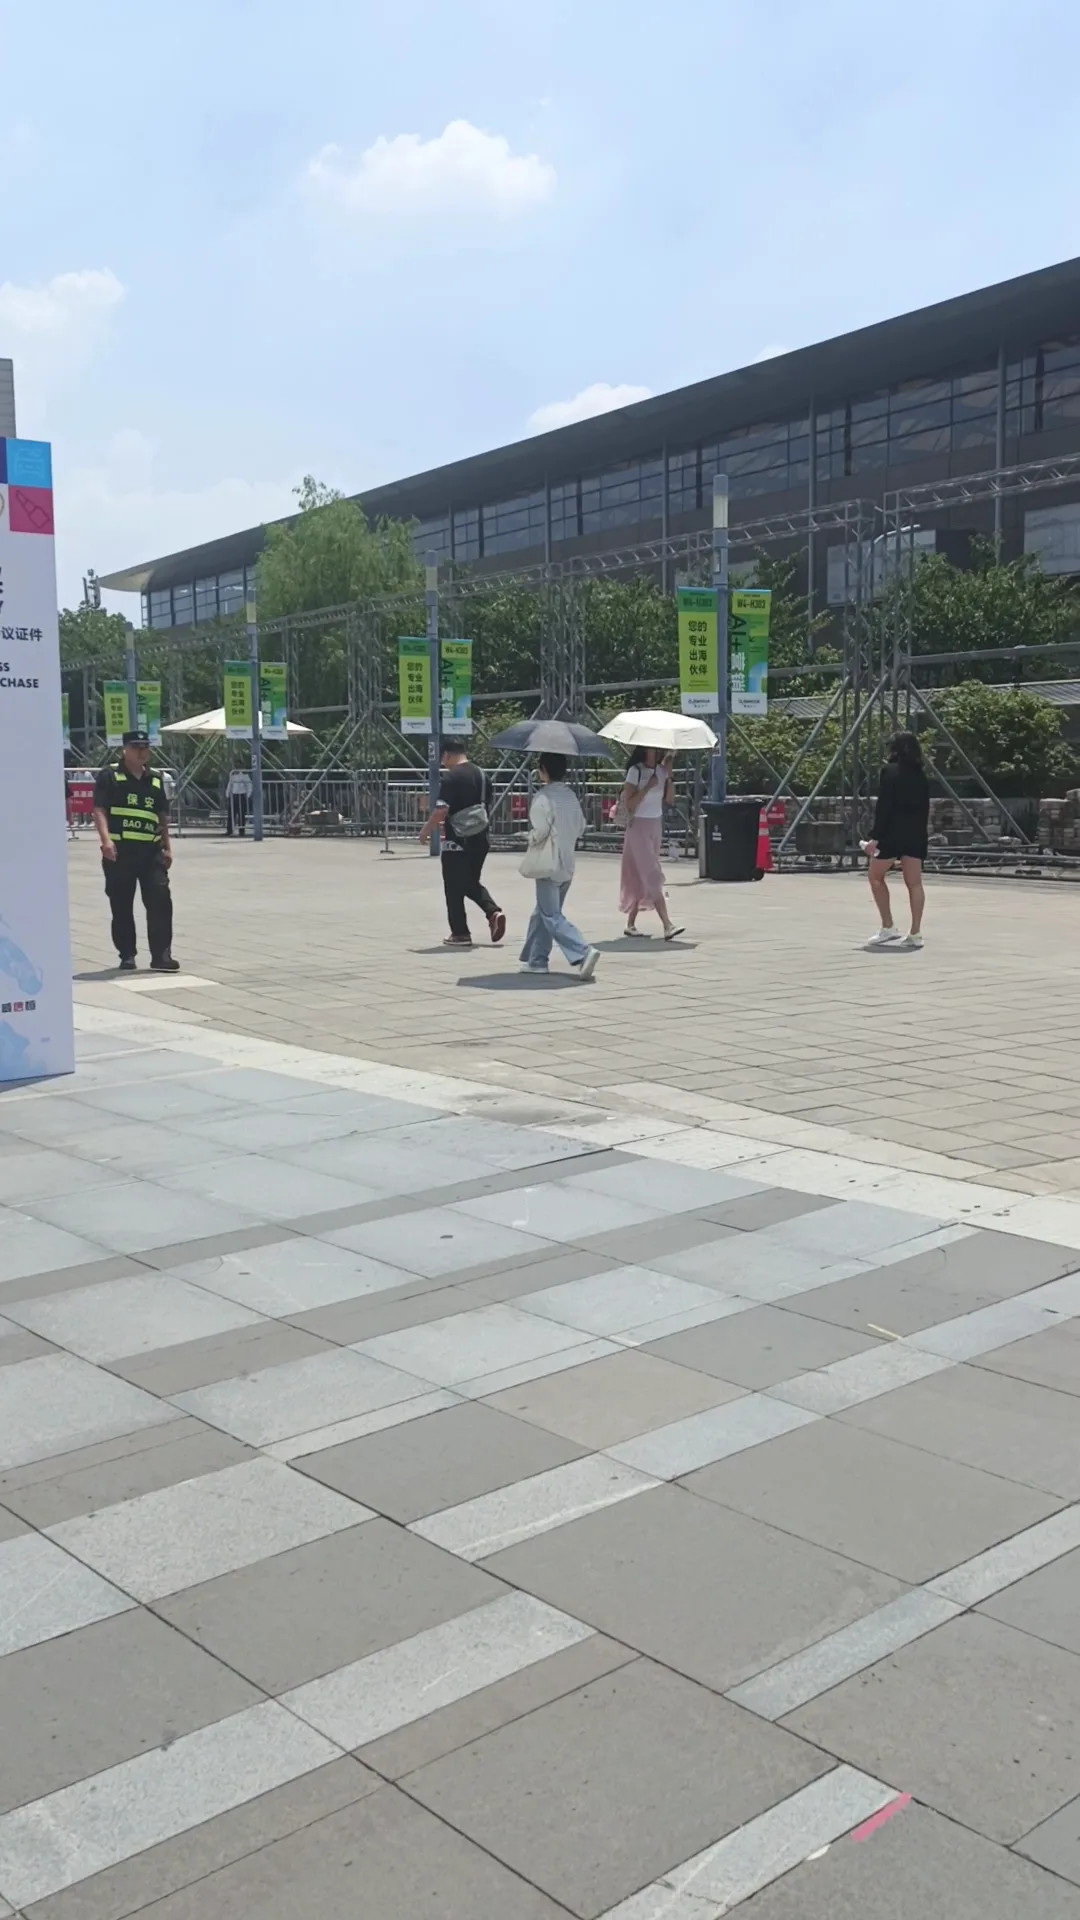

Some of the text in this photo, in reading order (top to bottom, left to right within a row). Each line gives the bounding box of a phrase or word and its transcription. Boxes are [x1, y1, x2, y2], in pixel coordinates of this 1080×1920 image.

[688, 620, 707, 632] 您的
[0, 626, 43, 642] 议证件
[688, 635, 707, 647] 专业
[689, 649, 707, 661] 出海
[407, 662, 423, 671] 您的
[690, 664, 708, 675] 伙伴
[0, 677, 38, 688] CHASE
[407, 673, 423, 682] 专业
[408, 684, 423, 693] 出海
[408, 695, 423, 704] 伙伴
[127, 793, 155, 809] 保安
[122, 819, 154, 832] BAO AN
